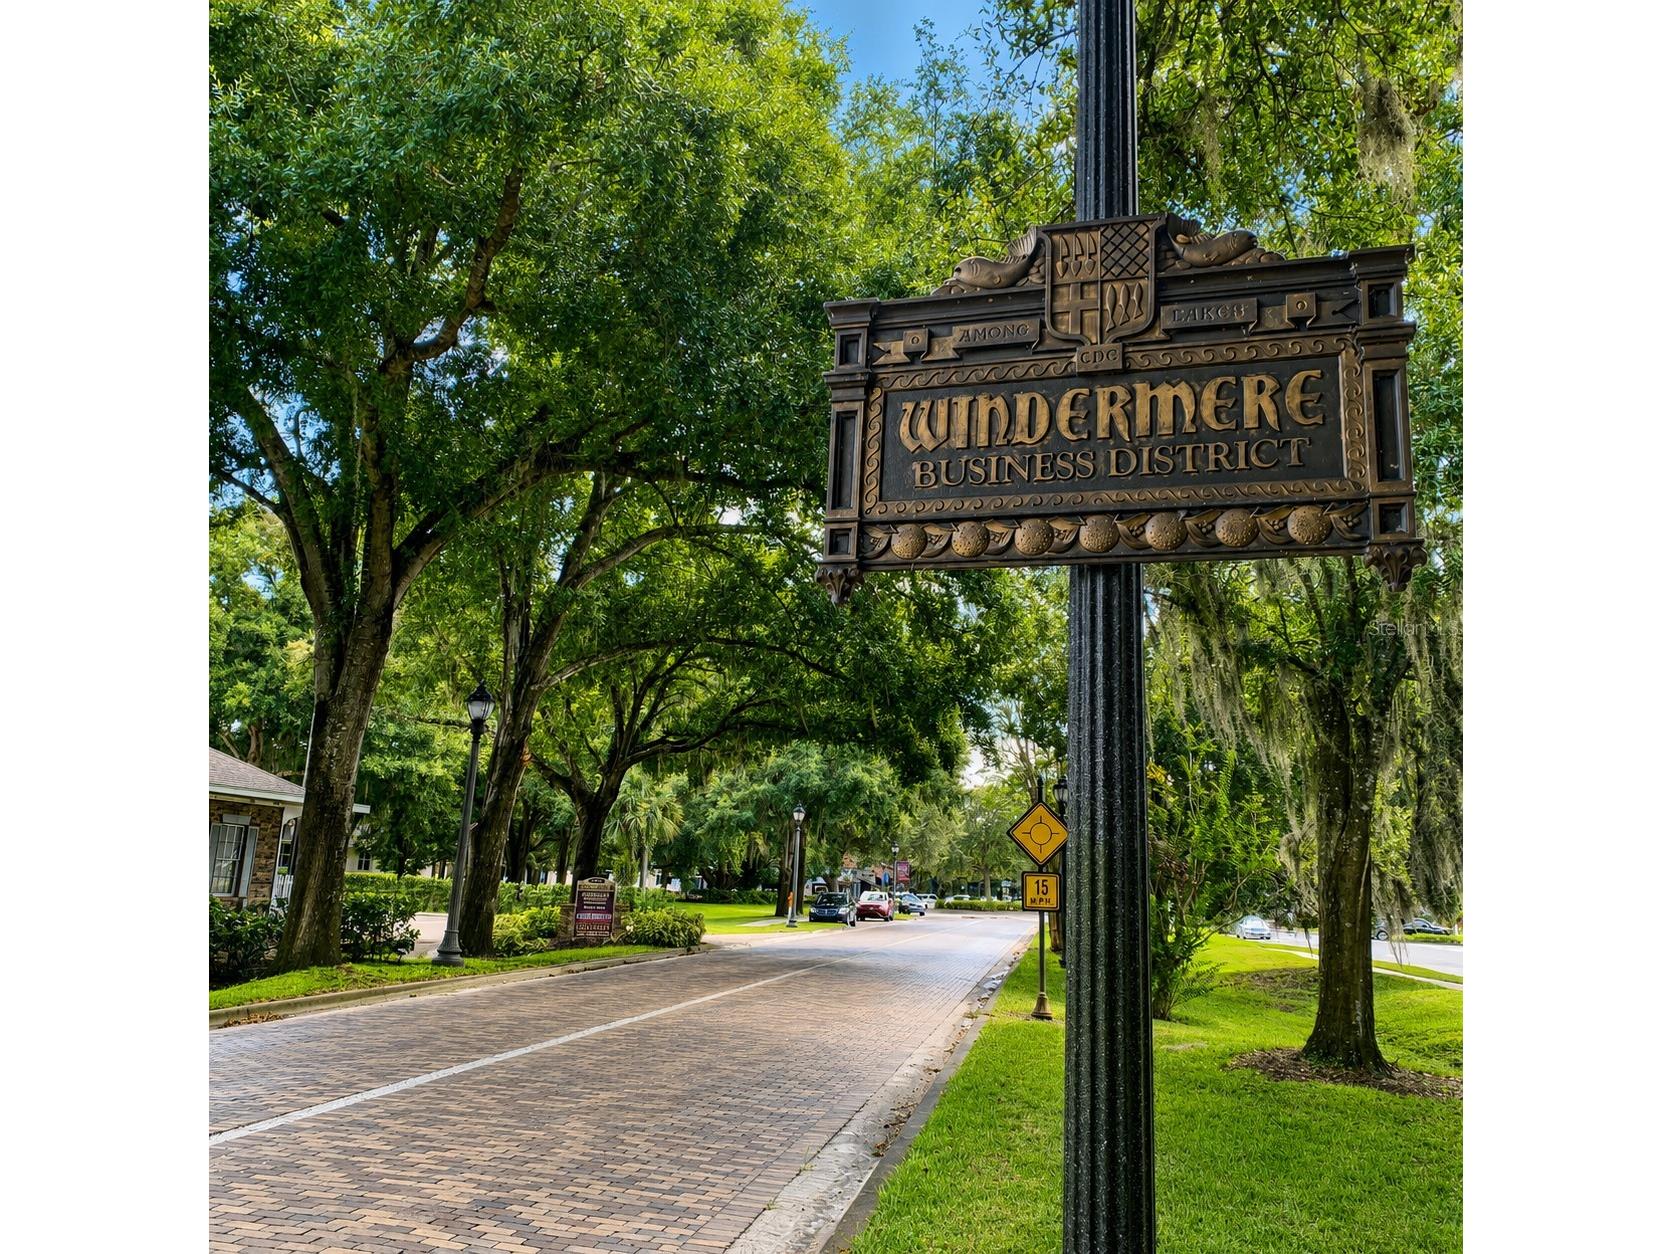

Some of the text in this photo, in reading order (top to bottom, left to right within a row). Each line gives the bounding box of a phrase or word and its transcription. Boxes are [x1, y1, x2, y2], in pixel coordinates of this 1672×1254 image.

[1172, 303, 1248, 323] LAKES
[958, 323, 1030, 342] AMONG
[899, 369, 1324, 453] WINDERMERE
[912, 436, 1311, 488] BUSINESS DISTRICT
[1034, 879, 1048, 896] 15
